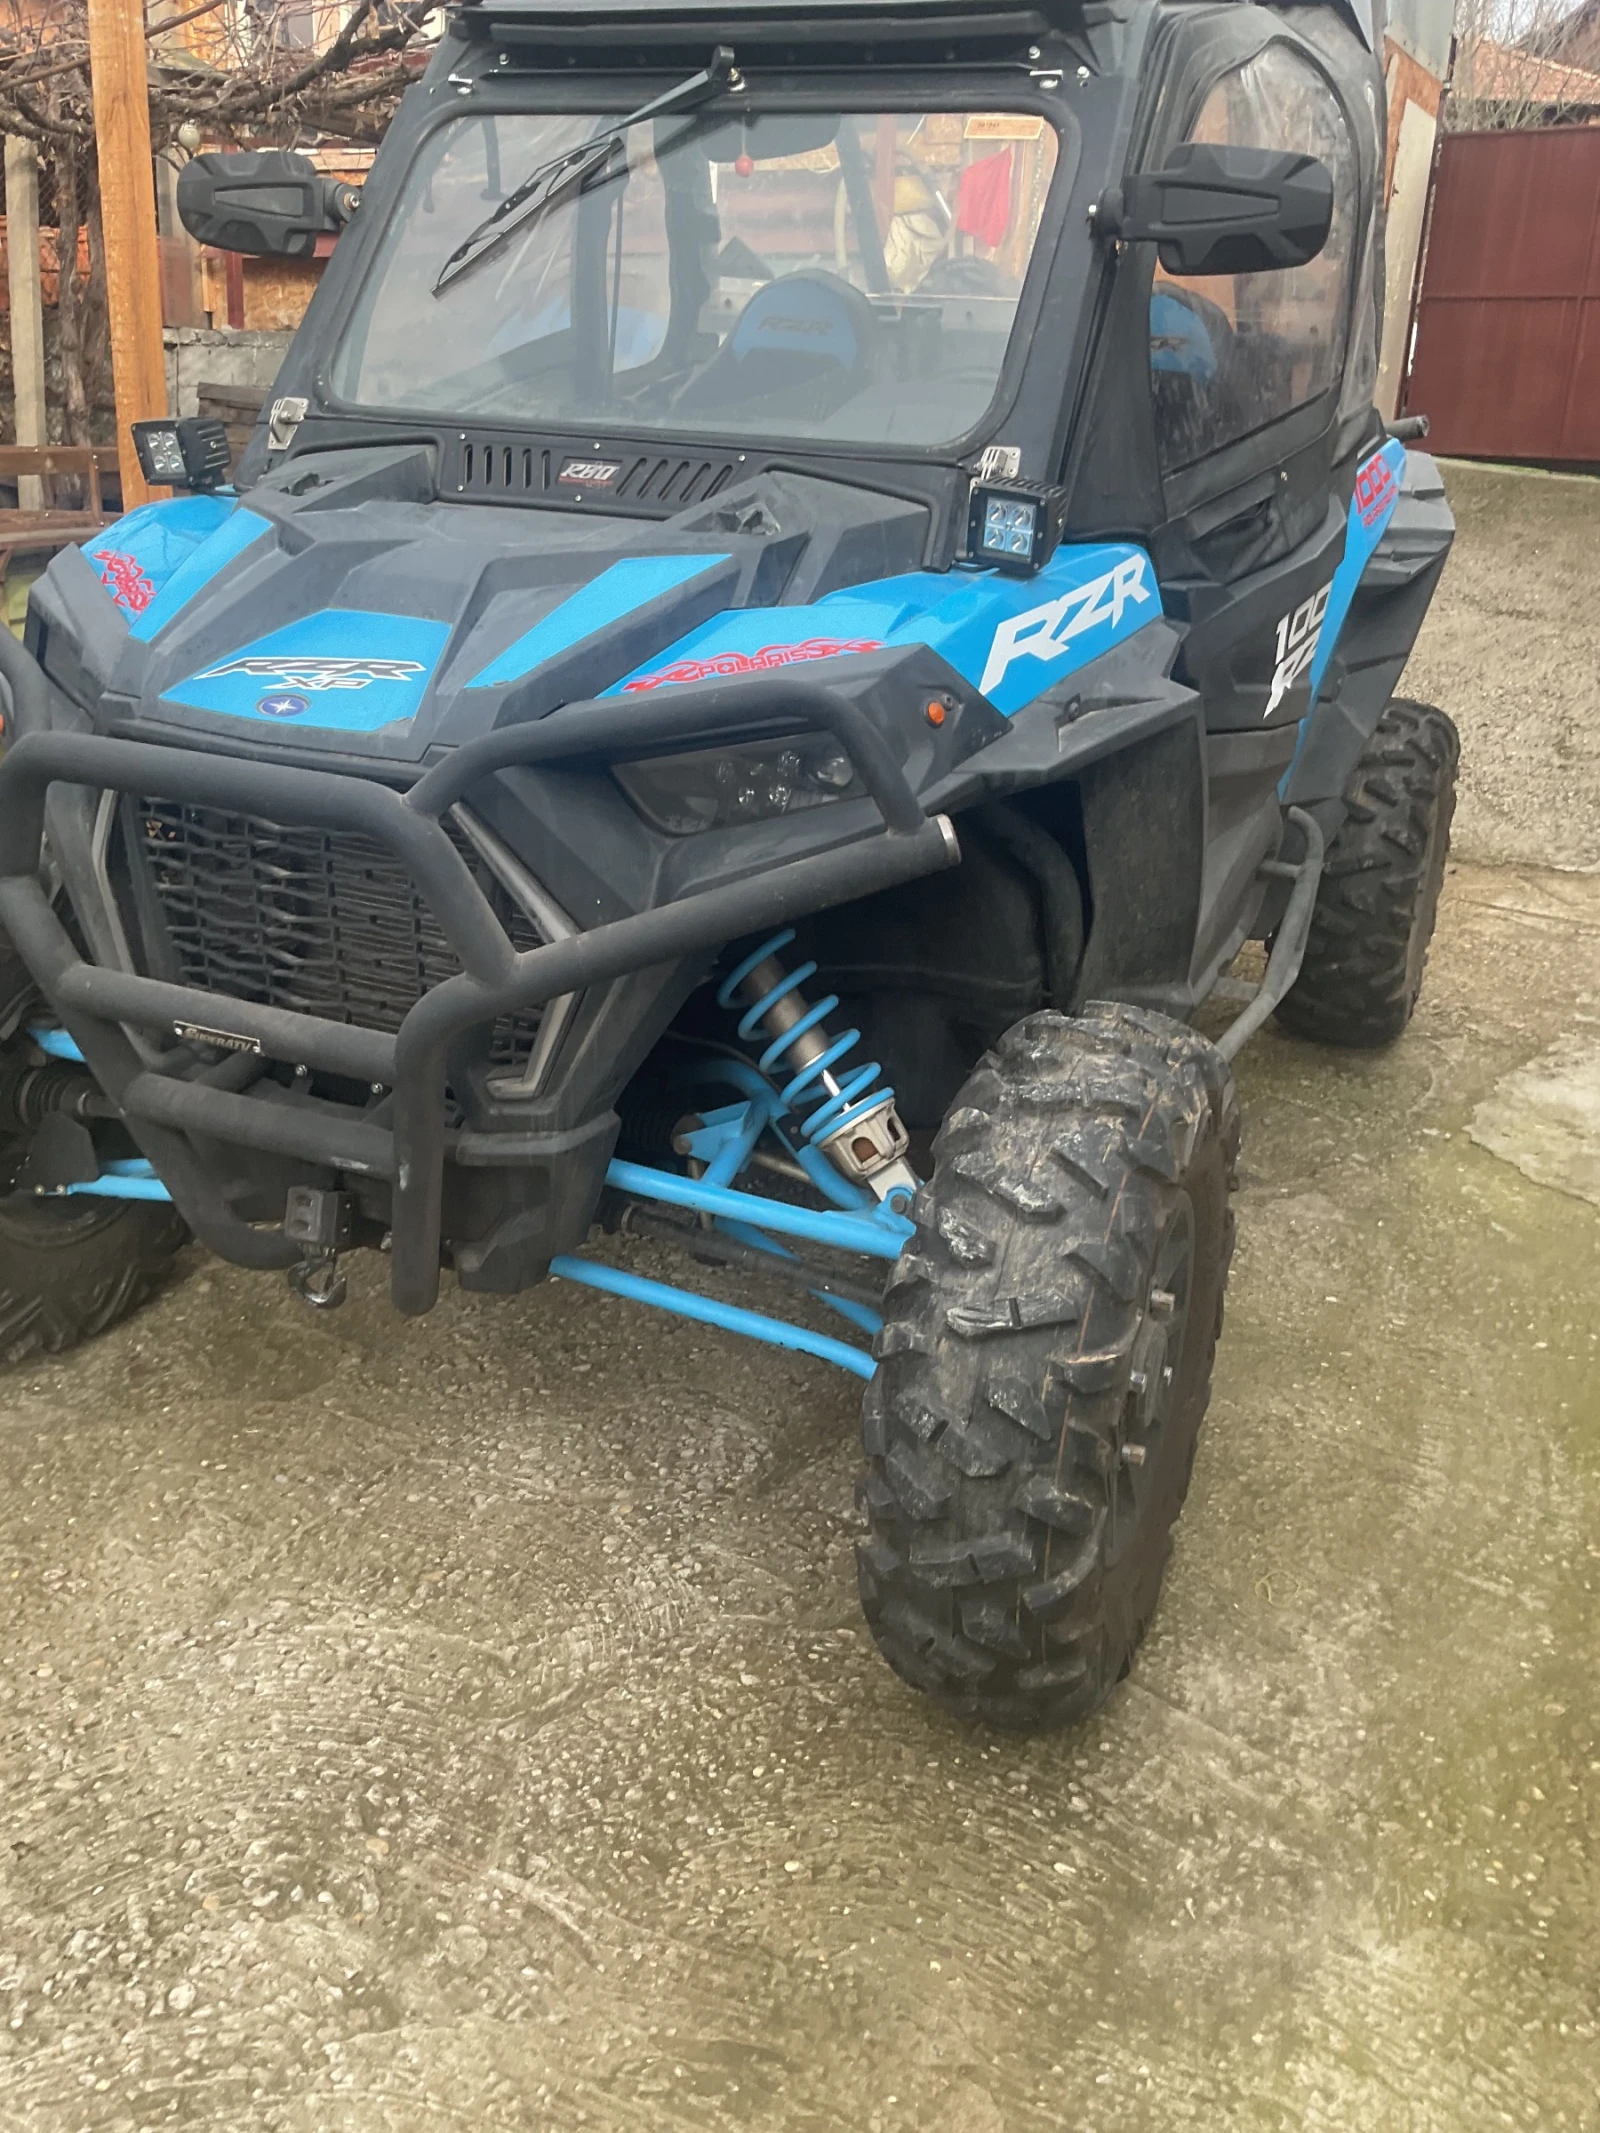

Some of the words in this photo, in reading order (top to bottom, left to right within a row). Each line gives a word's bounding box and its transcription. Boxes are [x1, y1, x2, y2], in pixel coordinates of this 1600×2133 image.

[699, 648, 811, 679] POLARIS
[979, 553, 1151, 696] RZR
[1274, 580, 1334, 666] 100
[193, 656, 428, 682] RZR
[1262, 625, 1323, 720] RZ
